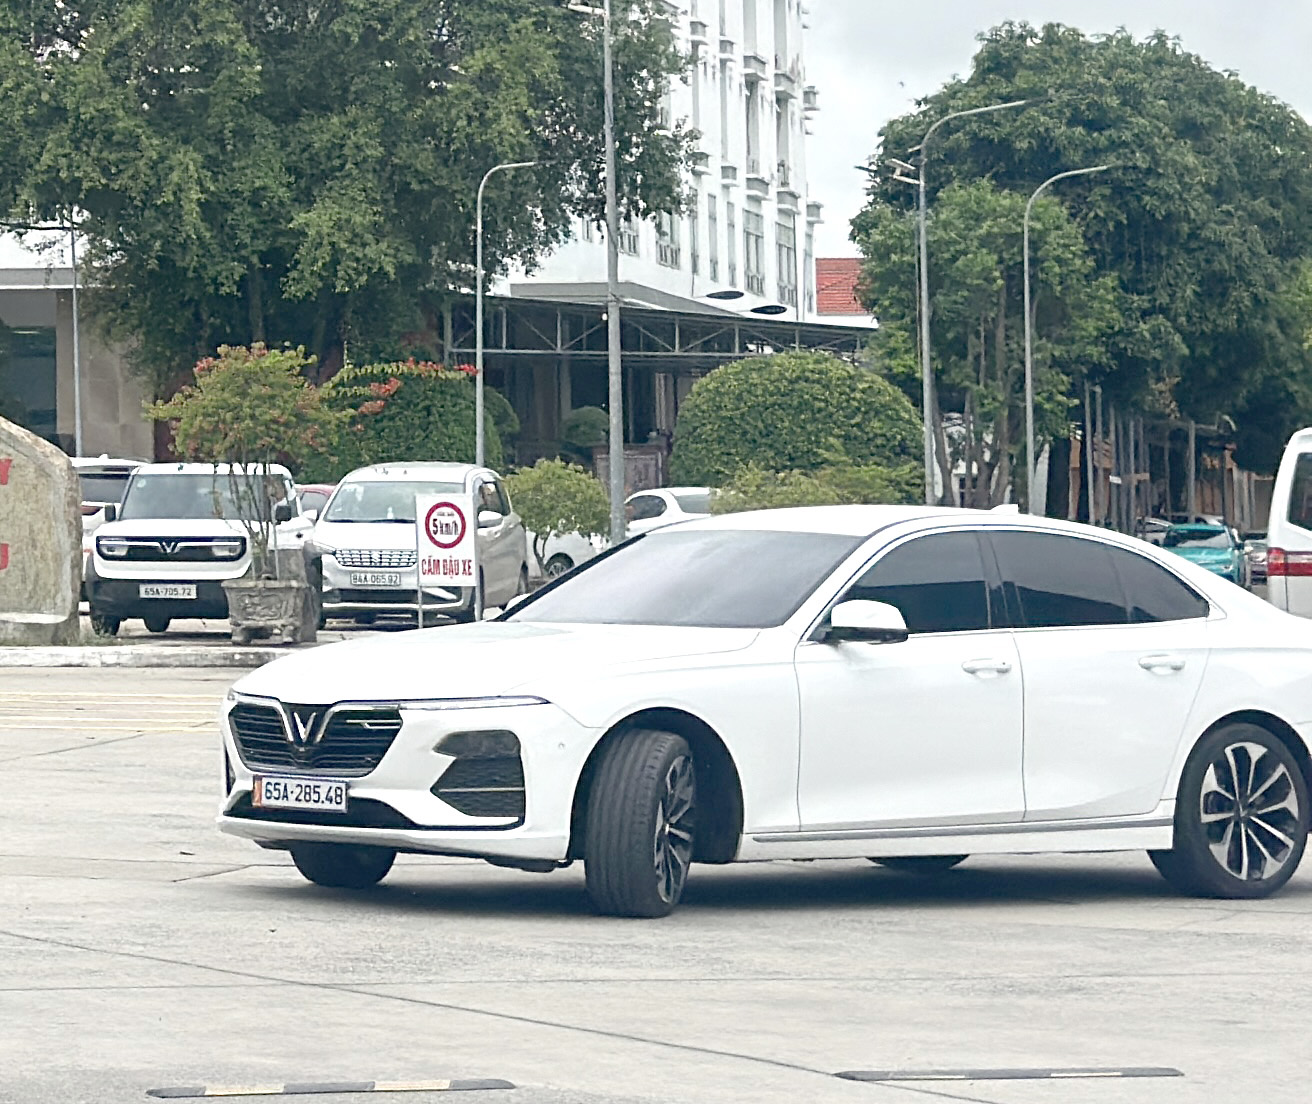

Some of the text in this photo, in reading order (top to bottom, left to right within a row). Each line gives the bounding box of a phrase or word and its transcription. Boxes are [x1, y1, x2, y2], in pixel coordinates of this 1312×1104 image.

[432, 518, 459, 535] 5 km/h
[462, 559, 472, 576] XE
